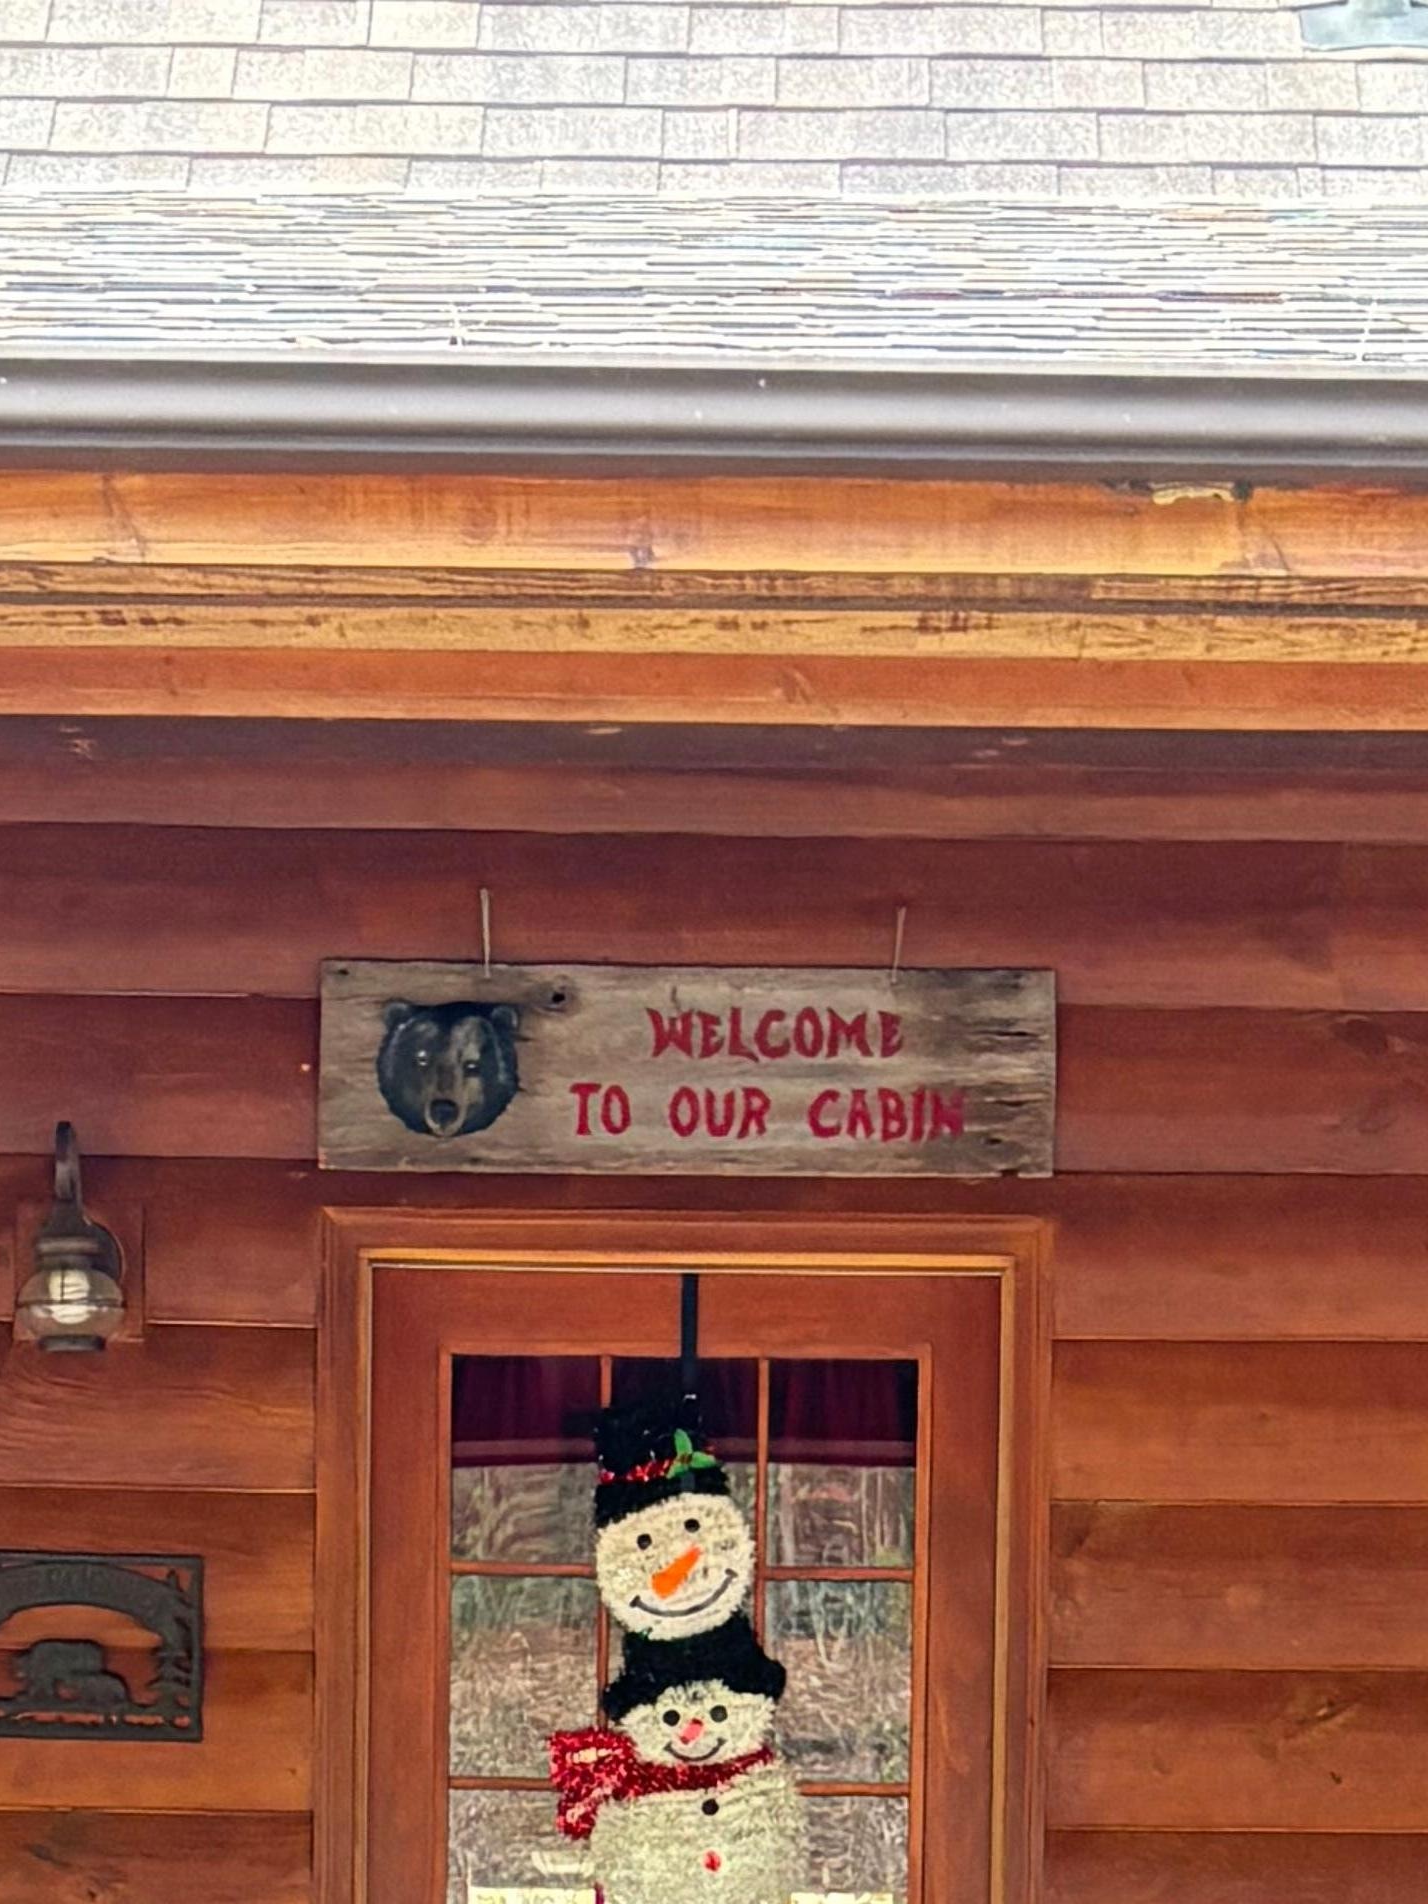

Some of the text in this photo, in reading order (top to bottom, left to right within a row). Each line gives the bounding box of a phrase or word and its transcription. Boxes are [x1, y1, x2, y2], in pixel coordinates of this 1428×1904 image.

[647, 1006, 905, 1062] WELCOME
[570, 1083, 969, 1144] TO OUR CABIN
